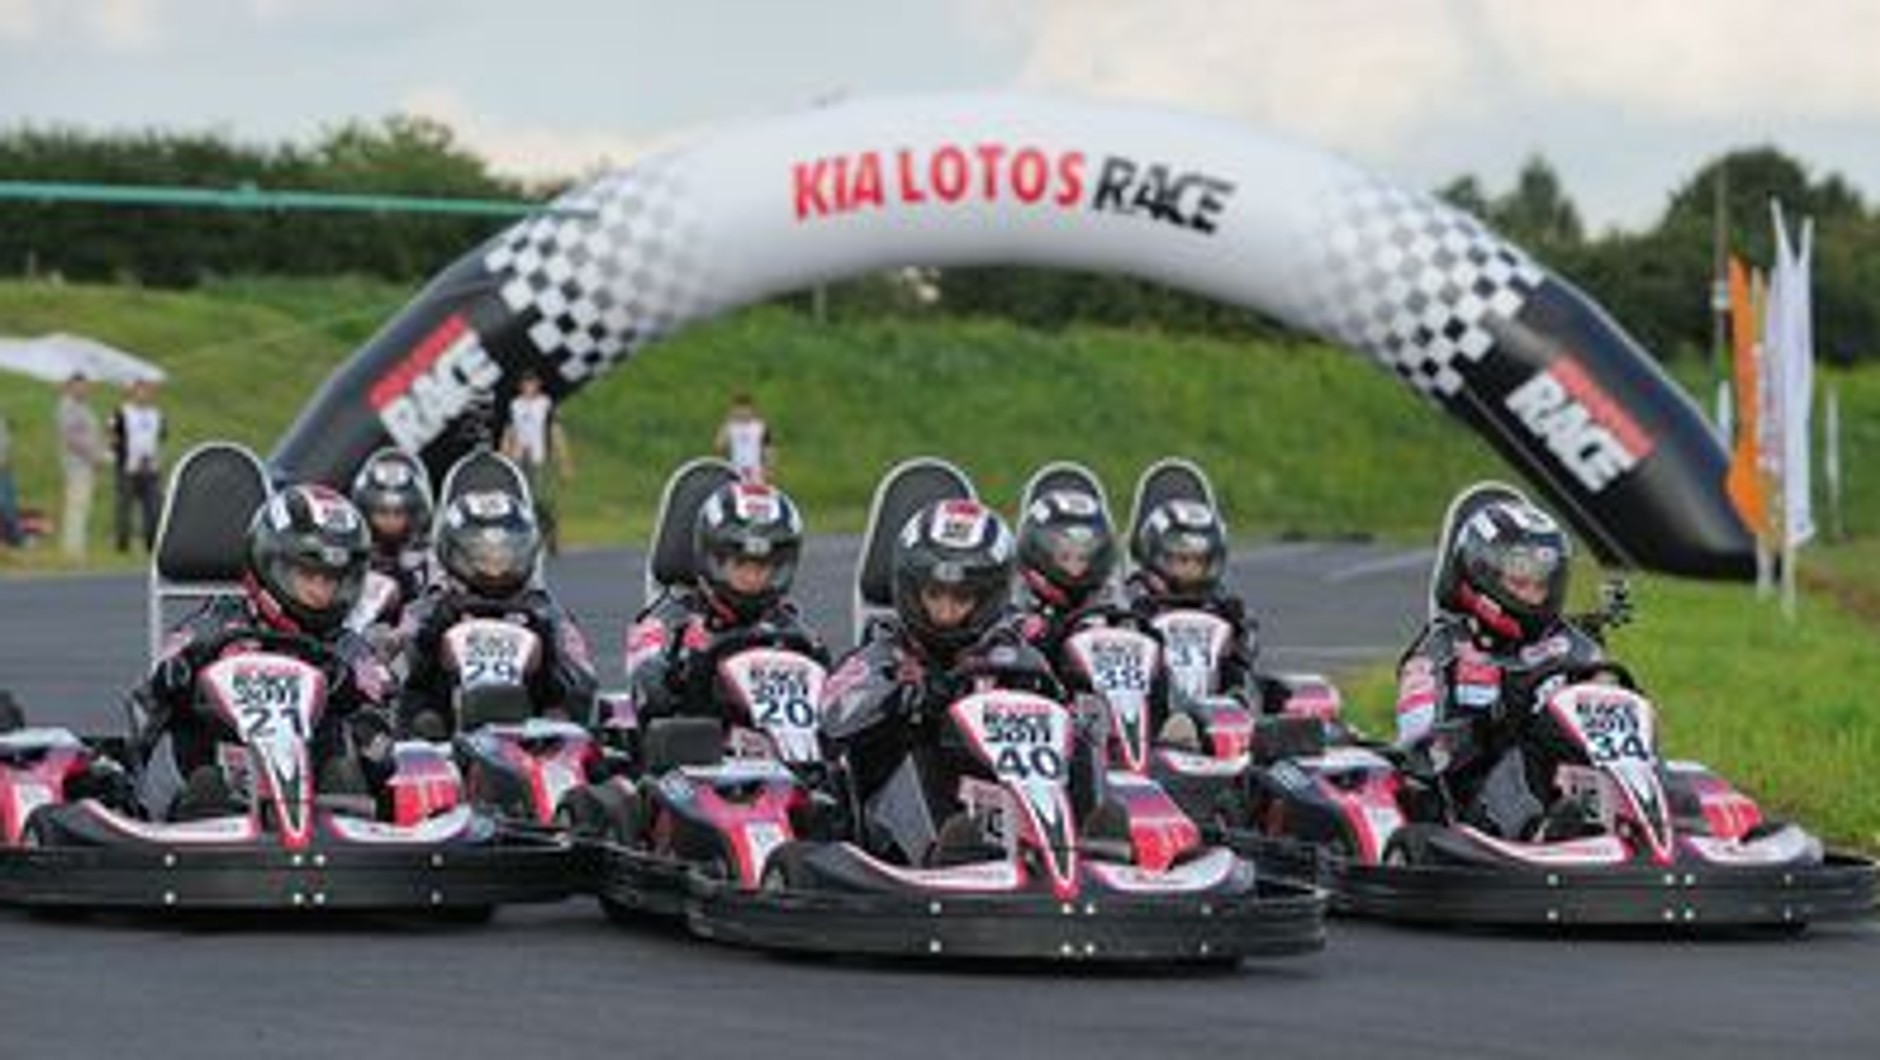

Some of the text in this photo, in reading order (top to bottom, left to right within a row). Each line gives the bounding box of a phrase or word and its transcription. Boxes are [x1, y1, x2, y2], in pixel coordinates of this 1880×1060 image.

[793, 144, 1236, 236] KIA LOTOS RACE
[380, 328, 502, 452] RACE
[1505, 370, 1637, 492] RACE
[242, 707, 303, 737] 21
[756, 699, 814, 728] 20
[997, 746, 1062, 779] 40
[1587, 732, 1649, 762] 34
